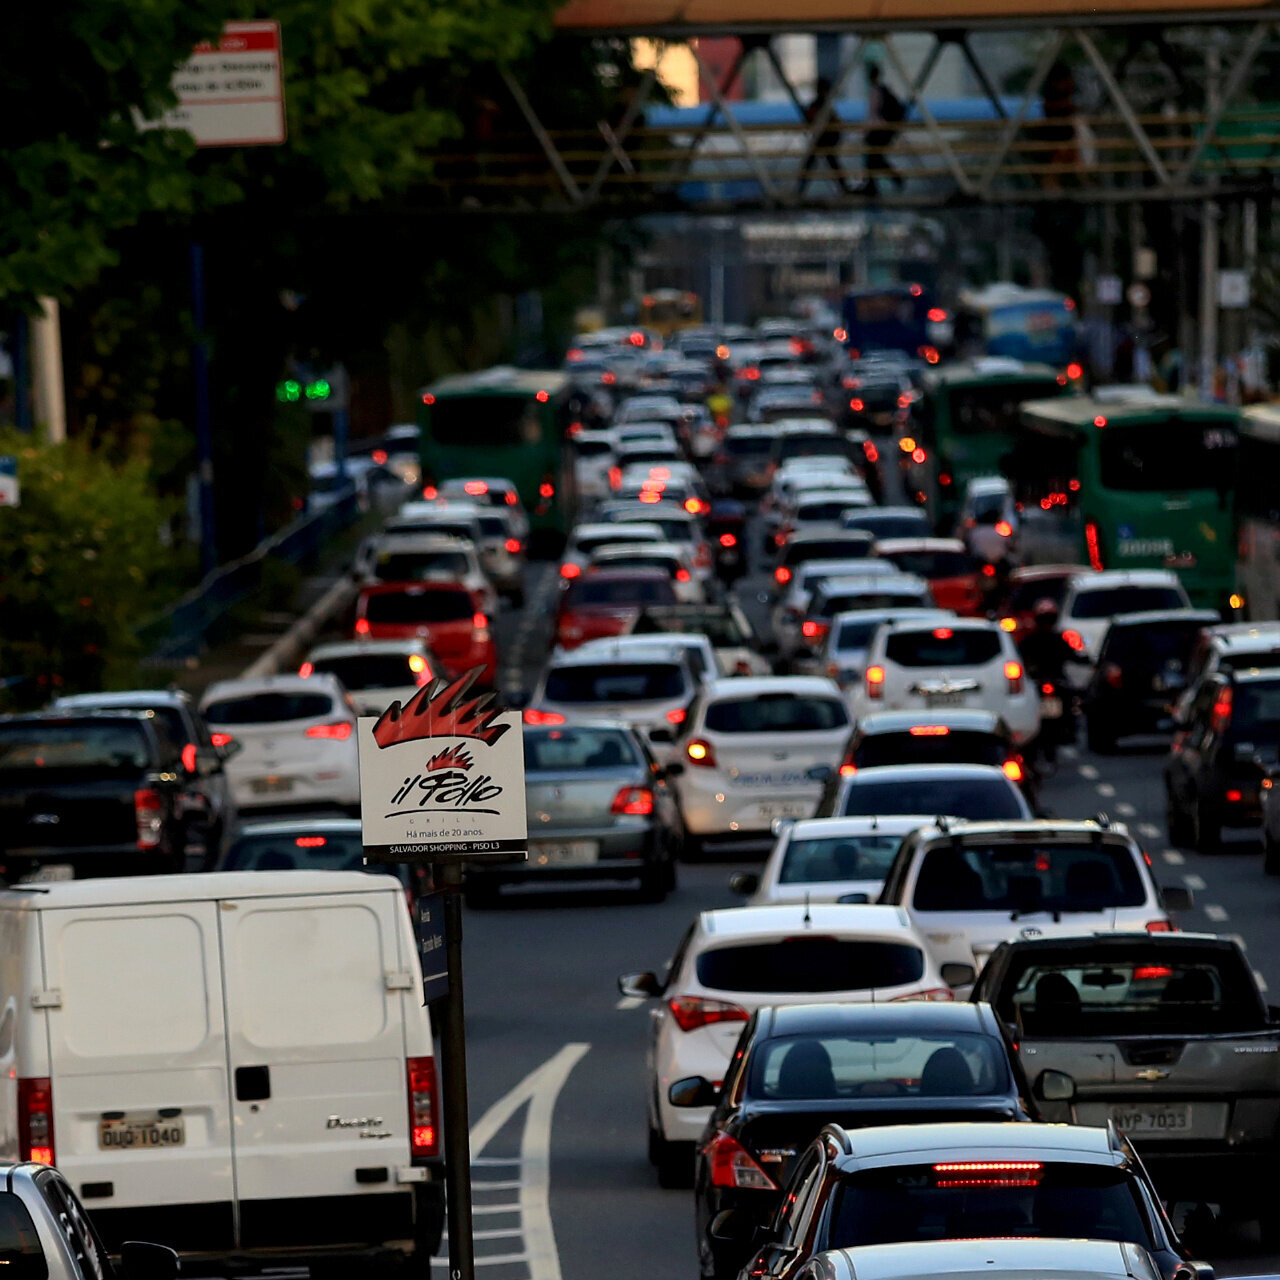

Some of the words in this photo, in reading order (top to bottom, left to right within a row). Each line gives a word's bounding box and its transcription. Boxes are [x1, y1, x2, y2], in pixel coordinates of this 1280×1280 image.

[418, 770, 503, 807] Pollo
[406, 830, 418, 839] Há
[419, 829, 438, 838] mais
[439, 829, 450, 837] de
[451, 828, 462, 837] 20
[389, 844, 429, 854] SALVADOR
[429, 843, 468, 853] SHOPPING
[472, 842, 490, 850] PISO
[490, 842, 500, 850] L3
